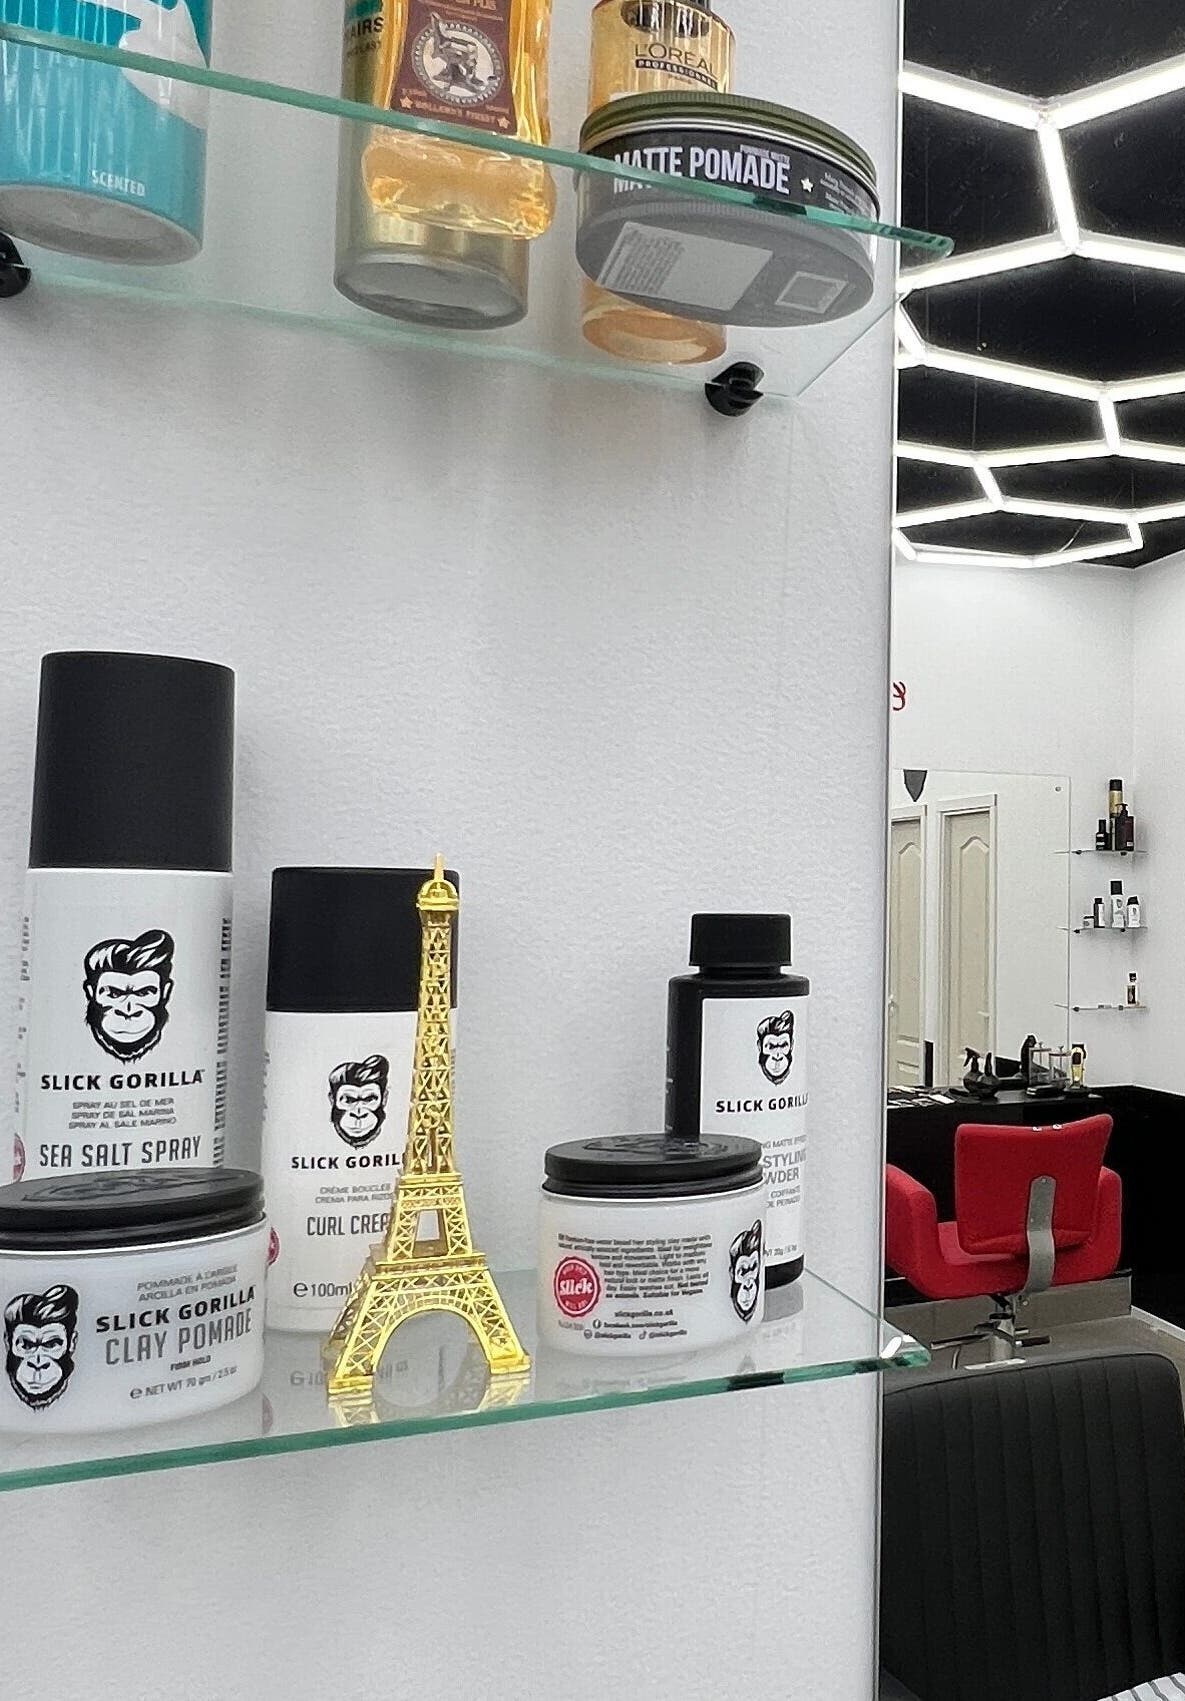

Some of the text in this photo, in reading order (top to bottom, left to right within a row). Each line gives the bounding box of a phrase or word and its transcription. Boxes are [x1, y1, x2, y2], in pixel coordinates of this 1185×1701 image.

[91, 169, 146, 197] SCENTED
[613, 146, 684, 183] MATTE
[690, 146, 791, 195] POMADE
[40, 1070, 203, 1090] SLICK GORILLA
[715, 1101, 764, 1113] SLICK
[40, 1135, 202, 1168] SEA SALT SPRAY
[290, 1153, 400, 1169] SLICK GORIL
[307, 1212, 390, 1236] CURL CREA
[96, 1286, 256, 1333] SLICK GORILLA
[105, 1308, 252, 1366] CLAY POMADE
[145, 1384, 165, 1397] NET
[167, 1380, 183, 1392] WT
